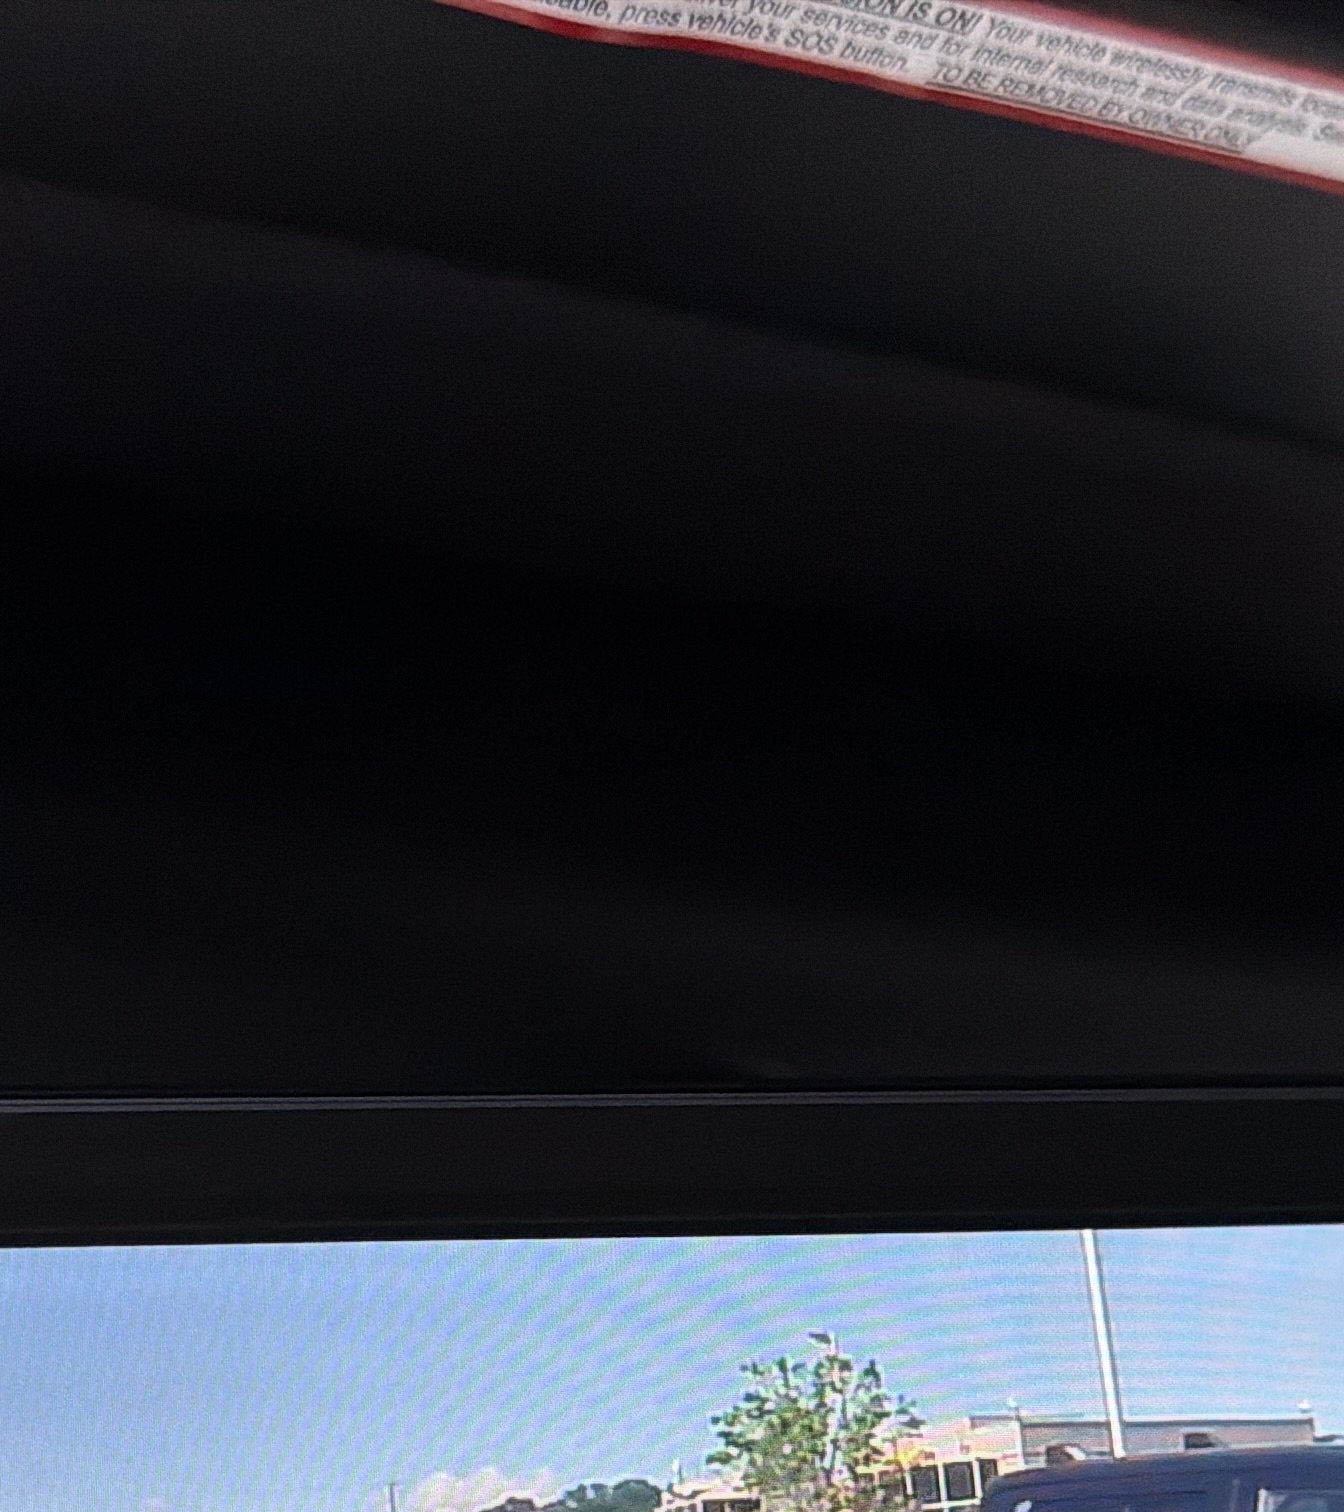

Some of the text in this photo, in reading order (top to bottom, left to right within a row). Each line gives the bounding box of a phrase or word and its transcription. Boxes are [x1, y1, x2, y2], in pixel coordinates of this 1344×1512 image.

[618, 3, 682, 27] press
[687, 10, 781, 42] vehicle's
[783, 27, 838, 55] SOS
[933, 60, 962, 84] TO
[962, 70, 994, 89] BE
[994, 77, 1098, 112] REMOVED
[1097, 100, 1130, 118] BY
[742, 0, 796, 20] your
[800, 8, 890, 41] services
[893, 28, 940, 51] and
[939, 36, 969, 57] for
[971, 42, 1052, 74] internal
[1052, 64, 1139, 95] research
[906, 0, 933, 21] IS
[935, 6, 983, 34] ON!
[987, 13, 1034, 42] Your
[1035, 31, 1107, 62] vehicle
